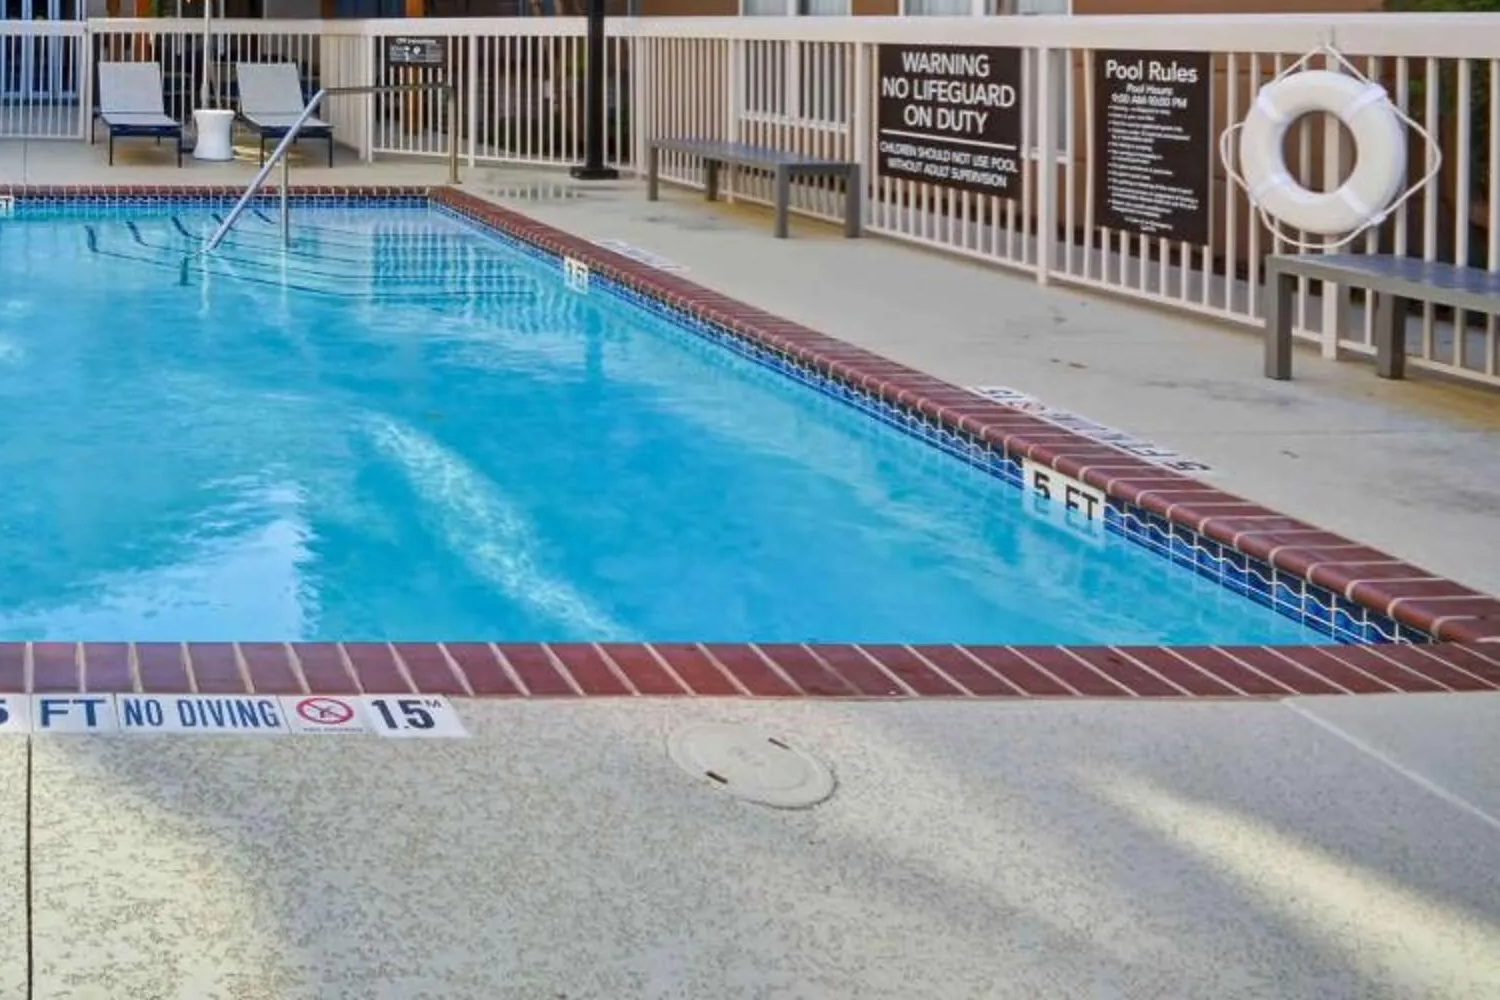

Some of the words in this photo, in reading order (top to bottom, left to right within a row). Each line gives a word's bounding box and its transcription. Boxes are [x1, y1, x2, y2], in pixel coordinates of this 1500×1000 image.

[901, 51, 990, 78] WARNING
[1105, 59, 1143, 81] Pool
[1148, 60, 1198, 83] Rules
[882, 76, 909, 99] NO
[913, 79, 1016, 108] LIFEGUARD
[903, 104, 933, 128] ON
[936, 107, 989, 134] DUTY
[991, 157, 1018, 173] POOL
[1033, 470, 1051, 501] 5
[1066, 484, 1099, 520] FT
[41, 699, 106, 727] FT
[124, 699, 163, 727] NO
[177, 699, 281, 728] DIVING
